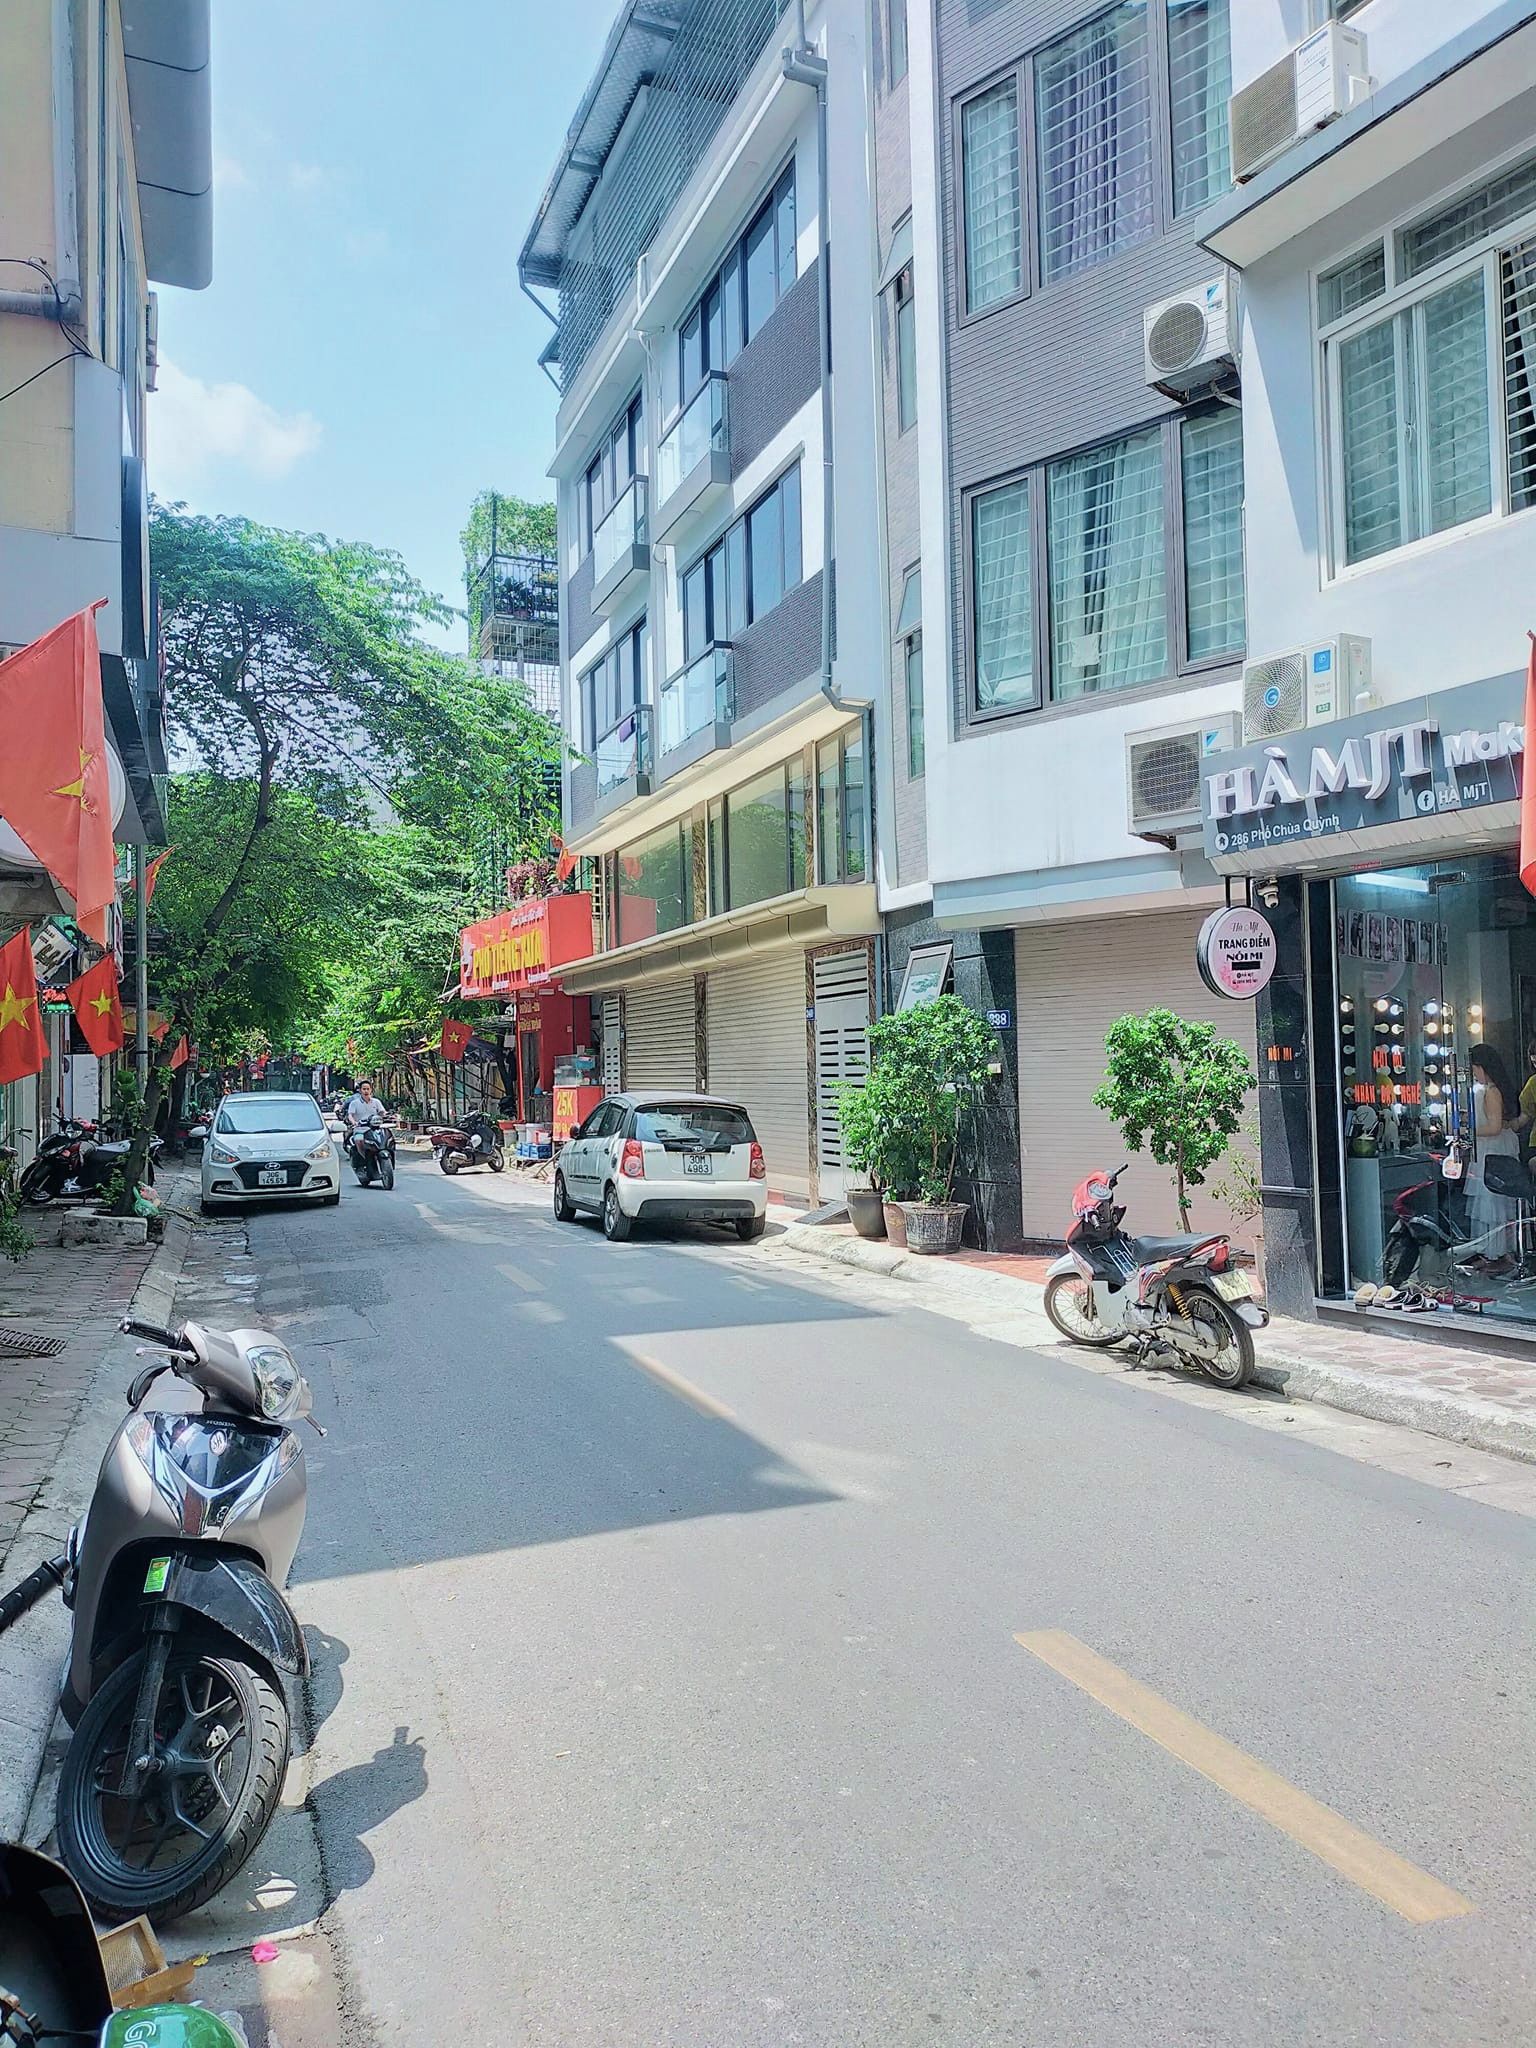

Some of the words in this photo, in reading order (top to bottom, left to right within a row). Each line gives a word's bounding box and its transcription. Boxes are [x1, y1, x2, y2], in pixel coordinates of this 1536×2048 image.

[1204, 746, 1306, 820] HÀ
[1443, 721, 1525, 769] Mak
[1231, 833, 1249, 846] 286
[1273, 822, 1300, 837] Chùa
[1303, 814, 1340, 832] Quỳnh
[1218, 938, 1248, 950] TRANG
[1249, 932, 1271, 948] ĐIỂM
[1250, 951, 1263, 960] MI
[557, 1091, 574, 1116] 25K
